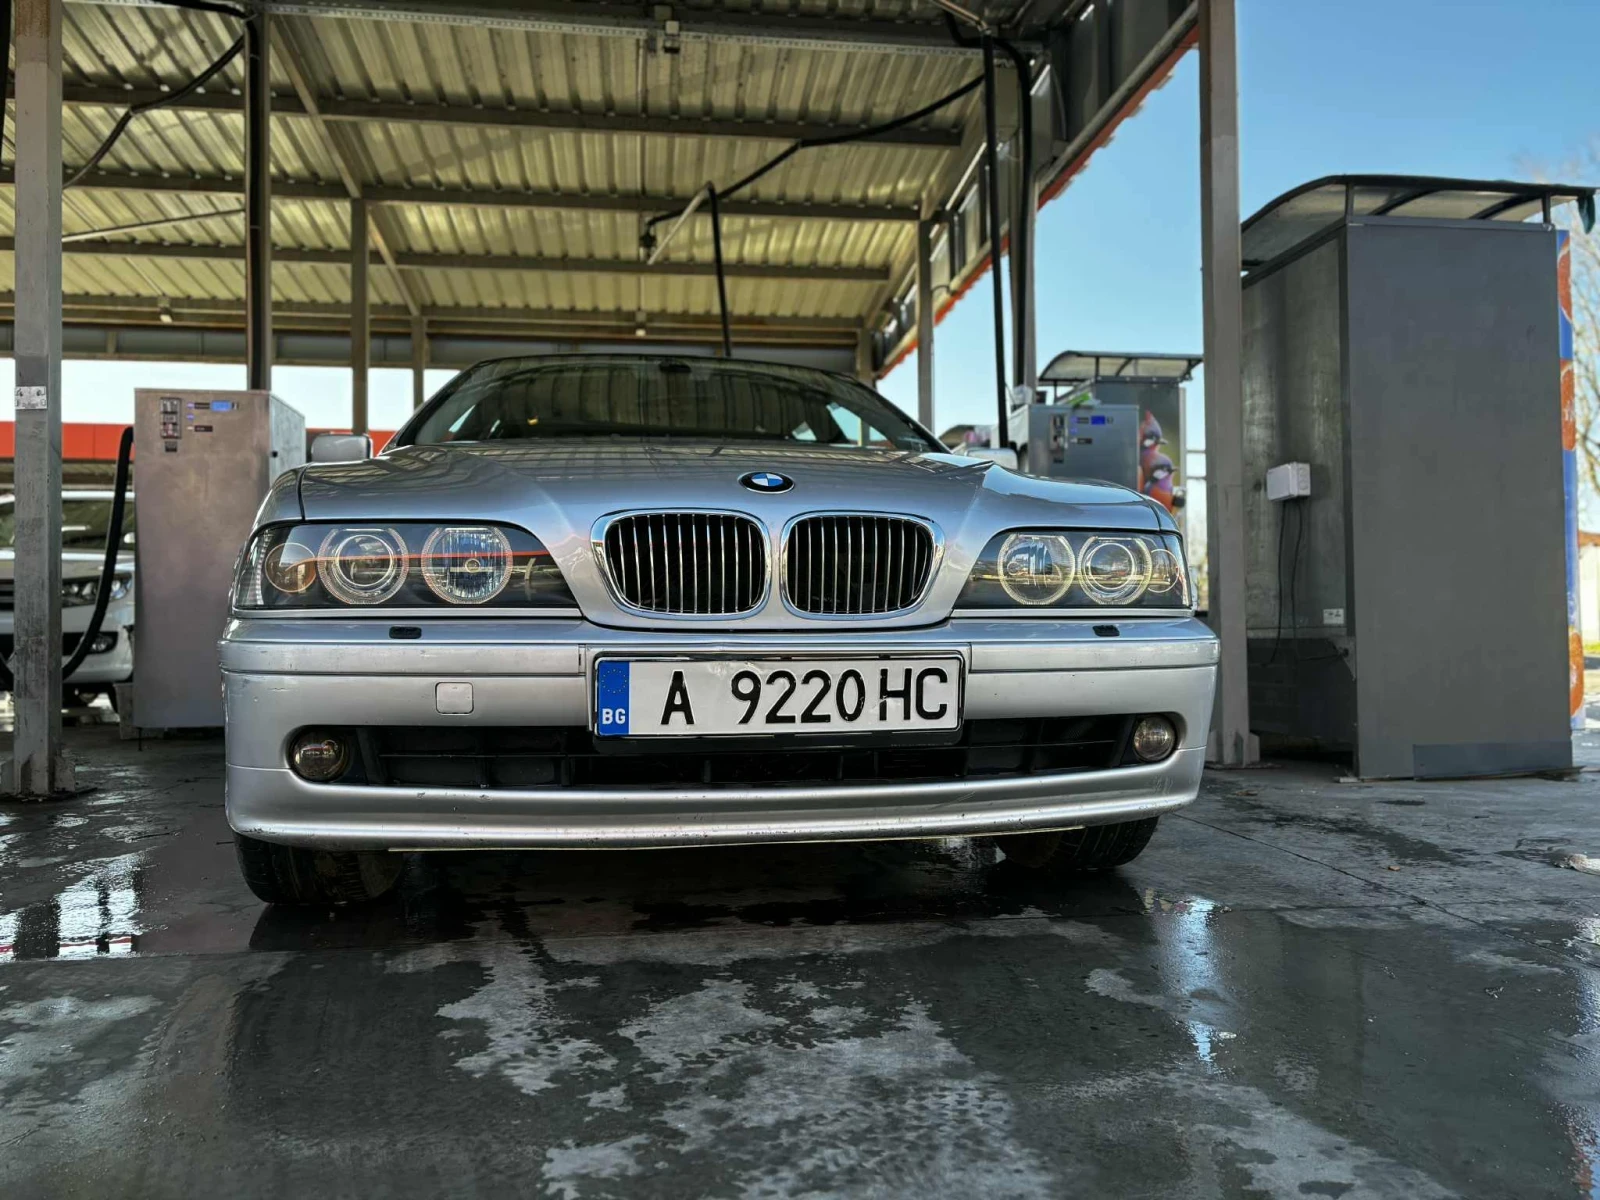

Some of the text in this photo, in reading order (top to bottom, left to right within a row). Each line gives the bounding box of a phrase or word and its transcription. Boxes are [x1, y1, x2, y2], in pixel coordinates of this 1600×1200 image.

[660, 667, 948, 725] A 9220 HC
[602, 708, 626, 725] BG
